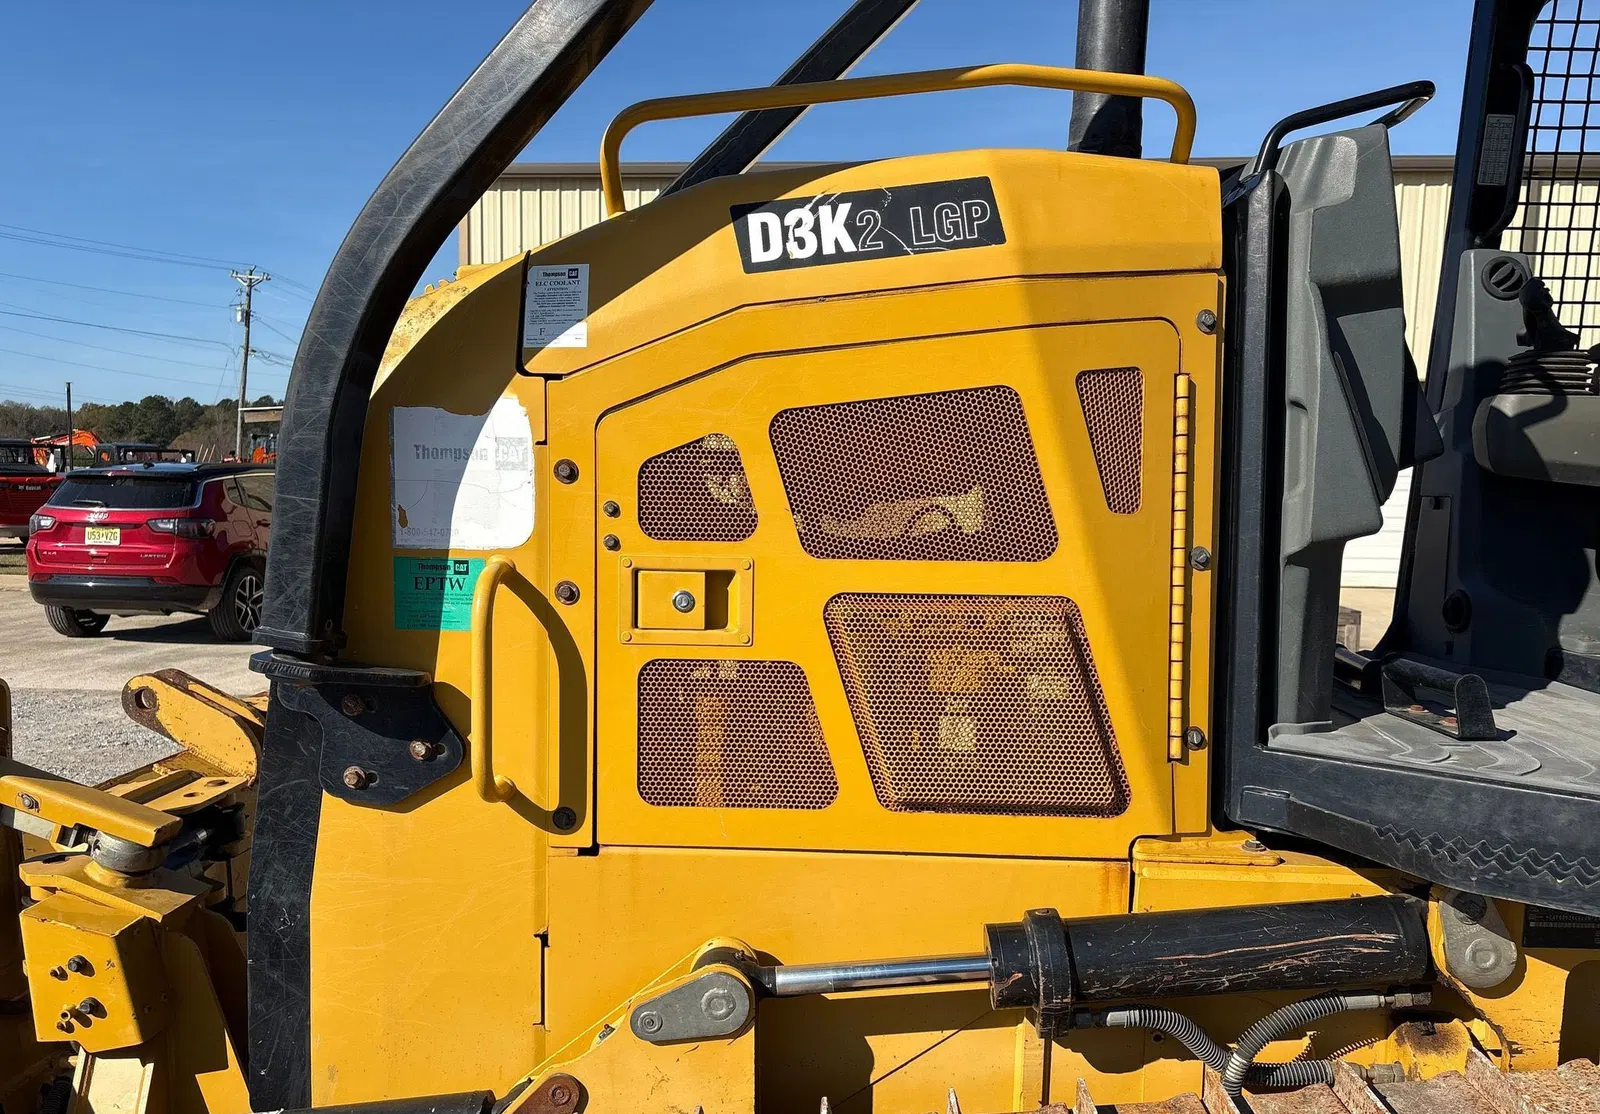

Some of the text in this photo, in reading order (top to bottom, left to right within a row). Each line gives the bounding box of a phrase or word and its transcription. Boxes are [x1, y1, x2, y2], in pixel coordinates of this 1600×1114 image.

[910, 199, 990, 246] LGP
[414, 443, 525, 463] Thompson CAT
[418, 562, 467, 572] Thompson CAT
[413, 576, 466, 591] EPTW
